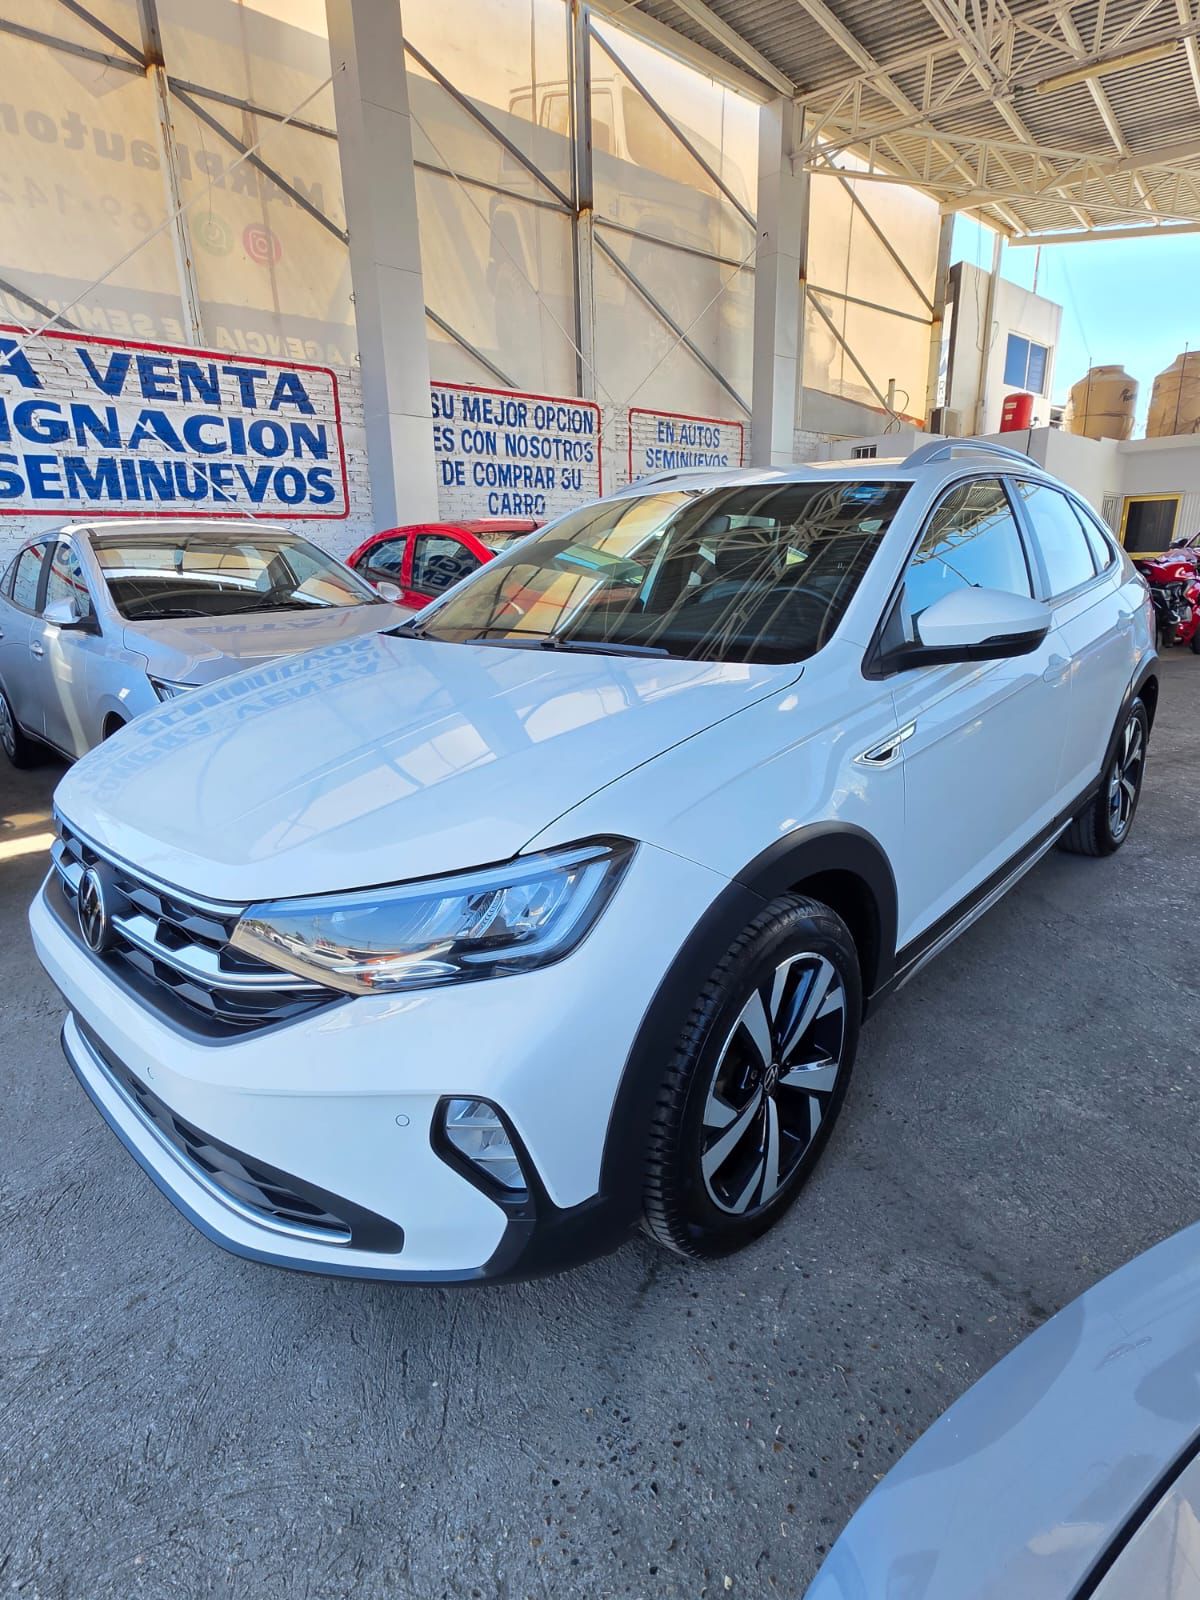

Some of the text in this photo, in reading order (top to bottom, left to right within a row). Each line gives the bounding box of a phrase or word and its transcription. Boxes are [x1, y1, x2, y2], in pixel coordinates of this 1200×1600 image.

[75, 347, 317, 415] VENTA
[462, 396, 528, 429] MEJOR
[534, 405, 594, 435] OPCION
[434, 426, 594, 463] ES CON NOSOTROS
[657, 421, 721, 449] EN AUTOS
[0, 454, 336, 504] SEMINUEVOS
[442, 460, 582, 490] DE COMPRAR SU
[488, 492, 546, 516] CARRO
